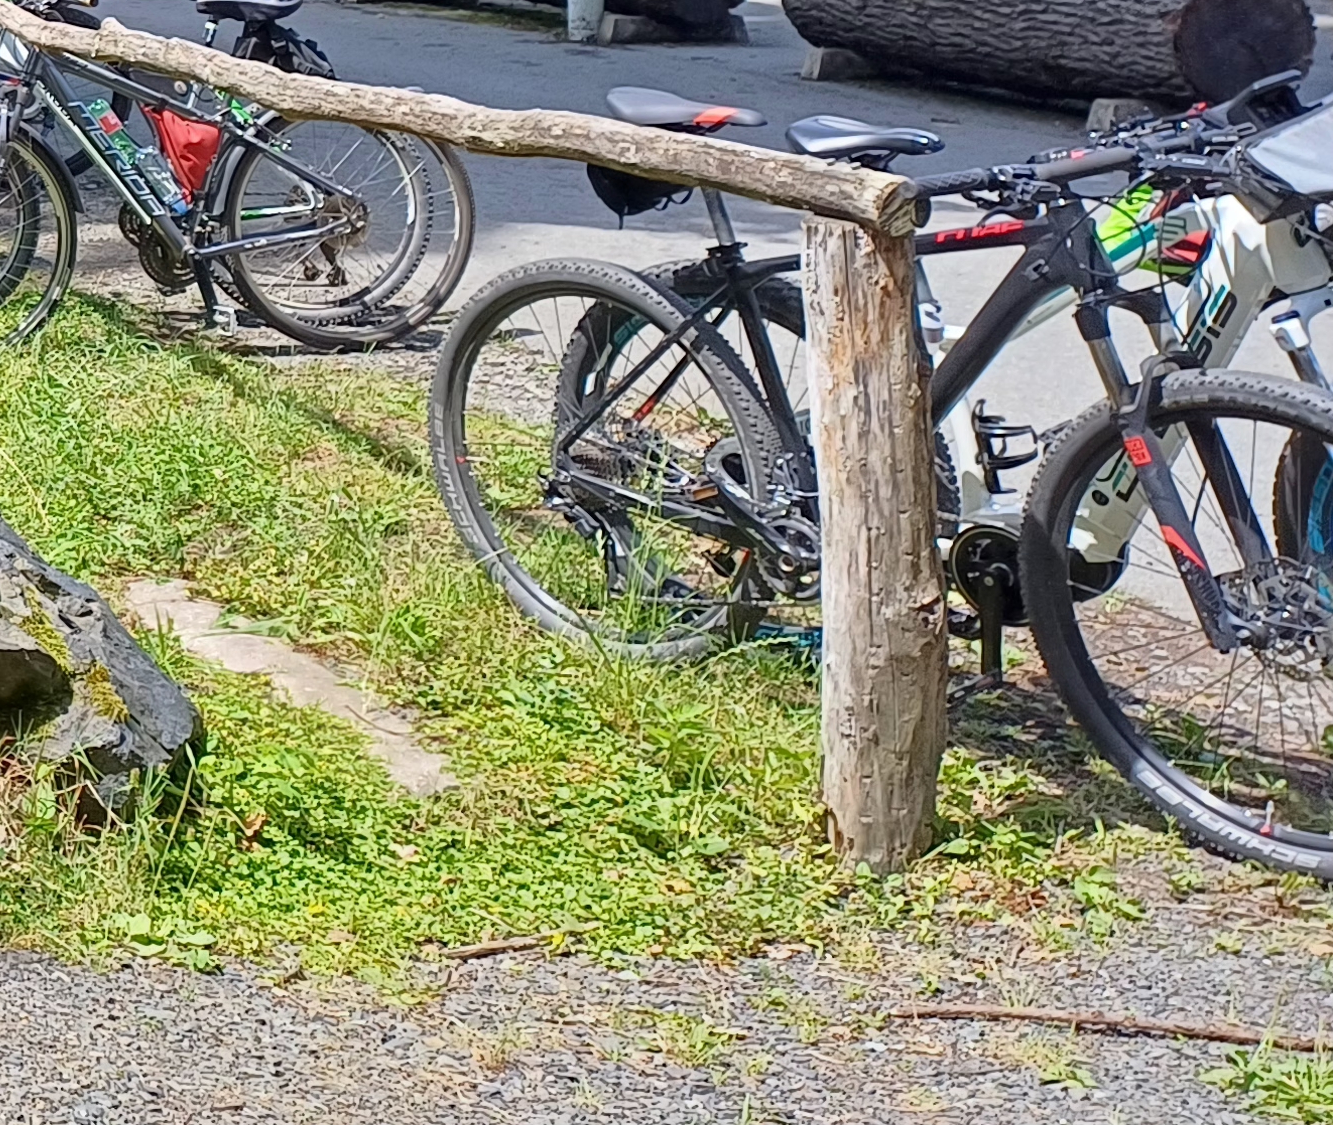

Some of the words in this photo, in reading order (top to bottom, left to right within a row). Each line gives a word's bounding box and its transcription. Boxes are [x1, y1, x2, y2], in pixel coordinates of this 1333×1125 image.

[68, 101, 166, 216] MERIDA
[434, 402, 480, 544] SCHWALBE
[1136, 770, 1322, 869] SCHWALBE
